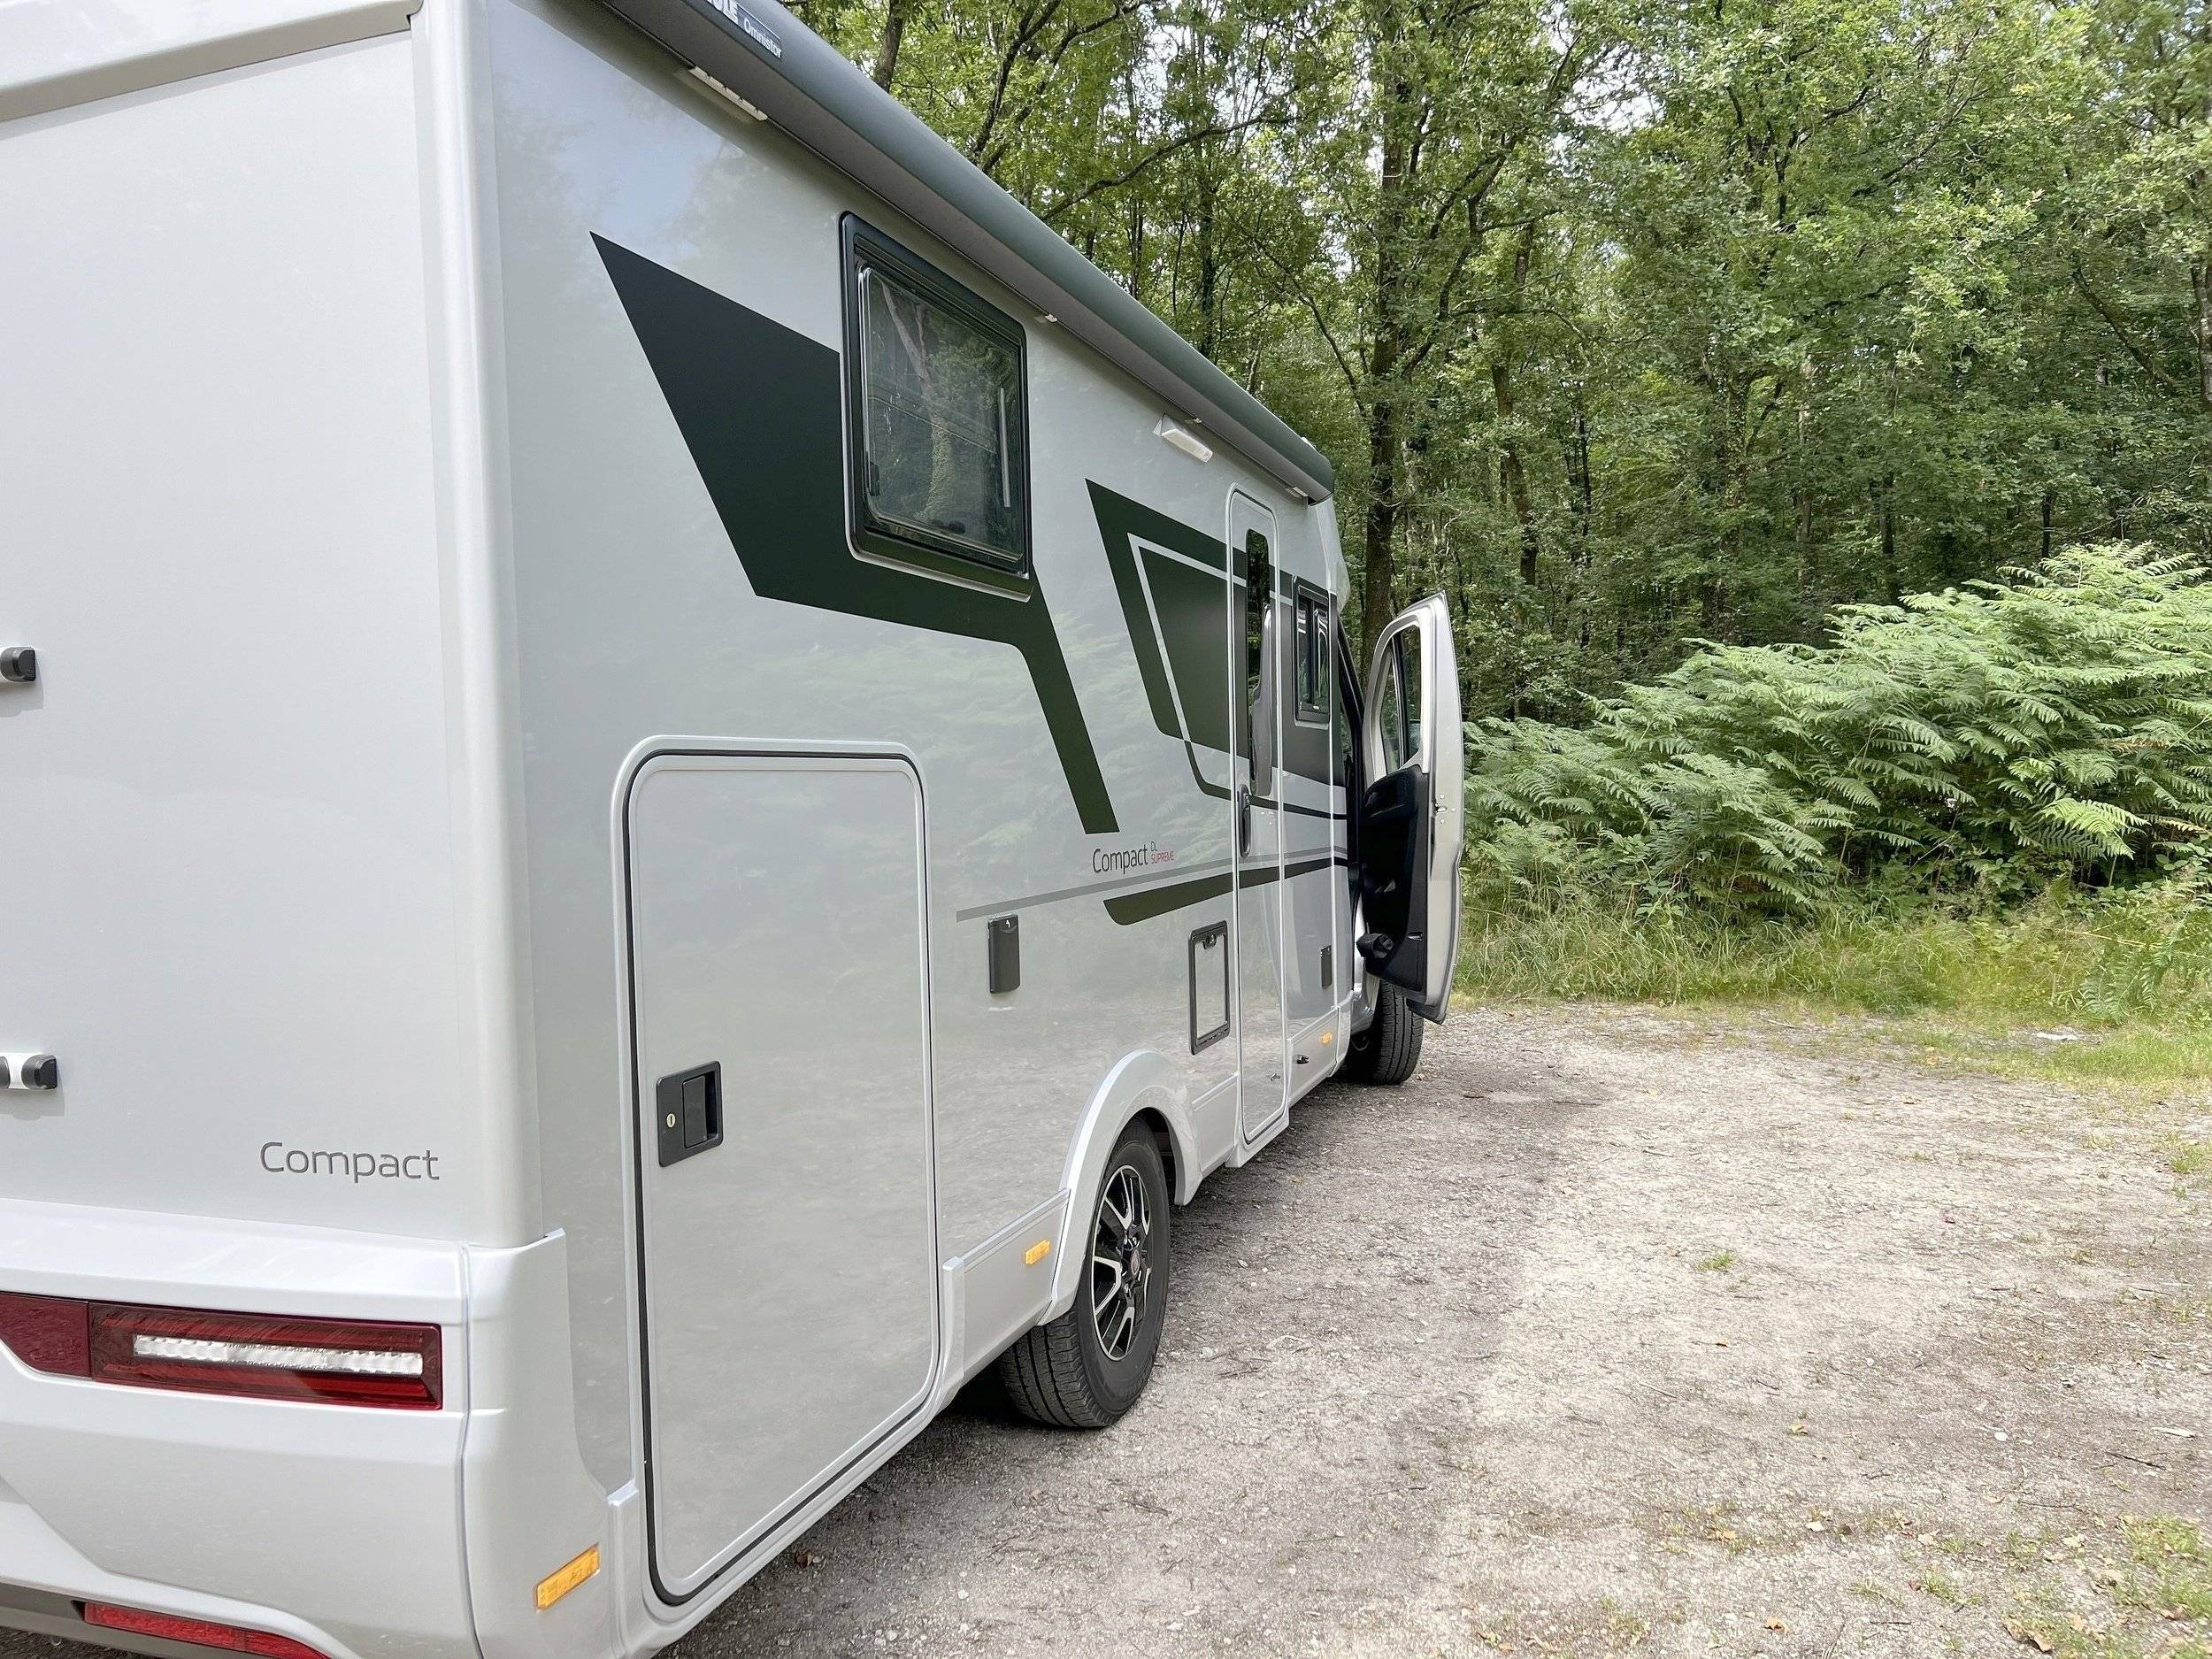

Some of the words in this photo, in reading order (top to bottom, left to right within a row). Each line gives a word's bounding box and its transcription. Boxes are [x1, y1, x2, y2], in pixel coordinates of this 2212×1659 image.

[743, 18, 781, 58] Omnistor
[1093, 844, 1148, 874] Compact
[260, 1141, 440, 1183] Compact
